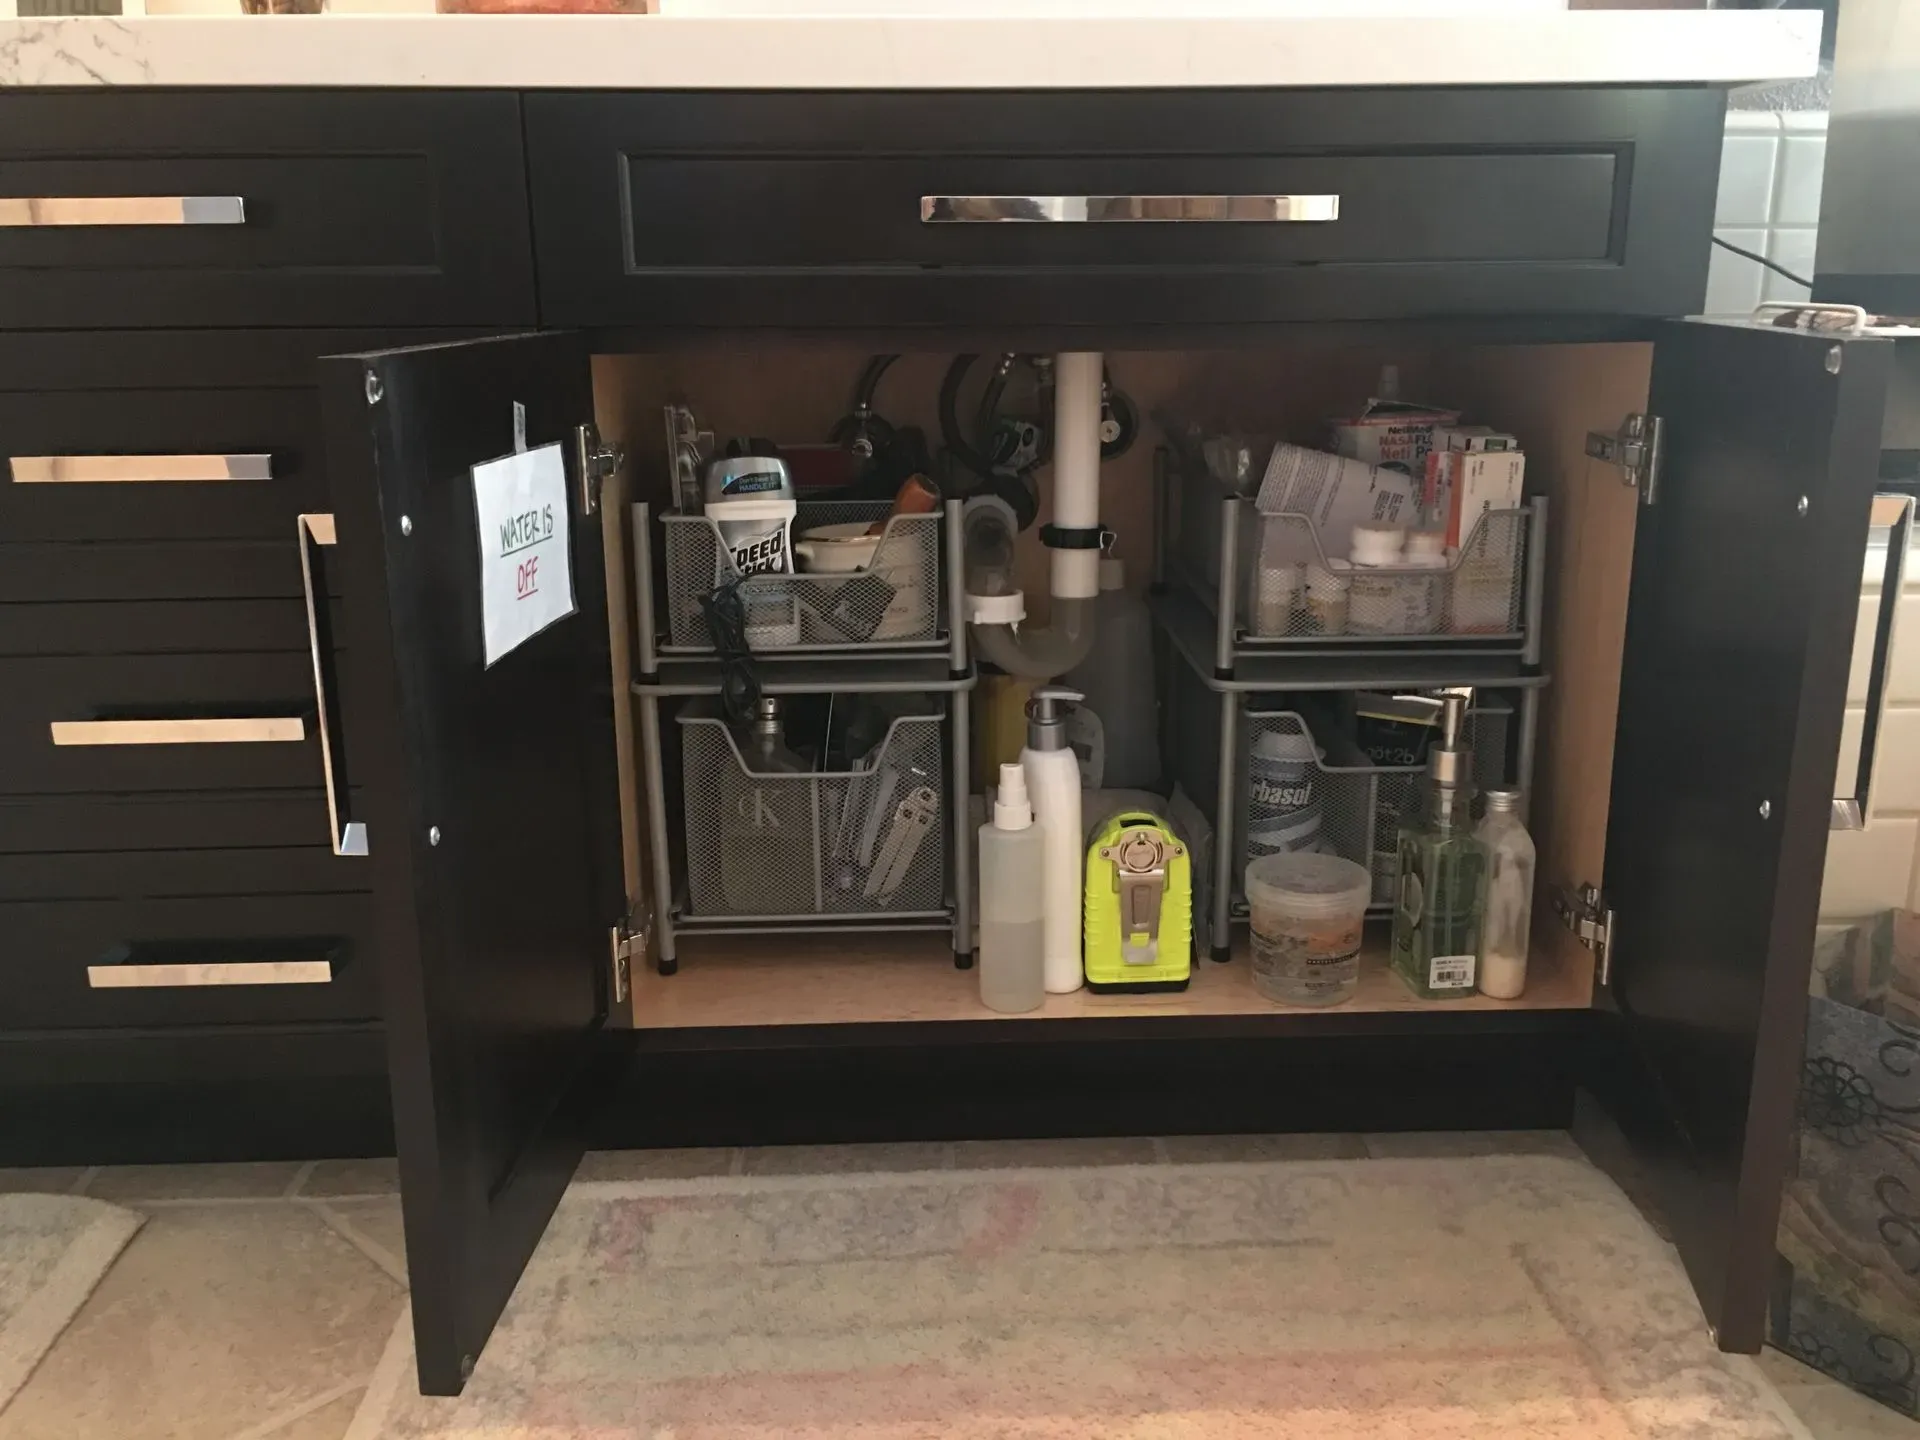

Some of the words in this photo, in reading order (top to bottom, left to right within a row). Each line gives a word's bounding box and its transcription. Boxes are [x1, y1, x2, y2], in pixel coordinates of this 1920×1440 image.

[1381, 446, 1411, 460] Neti
[1416, 447, 1433, 459] Po
[500, 510, 539, 551] WATER
[542, 503, 554, 536] IS
[517, 556, 539, 593] OFF
